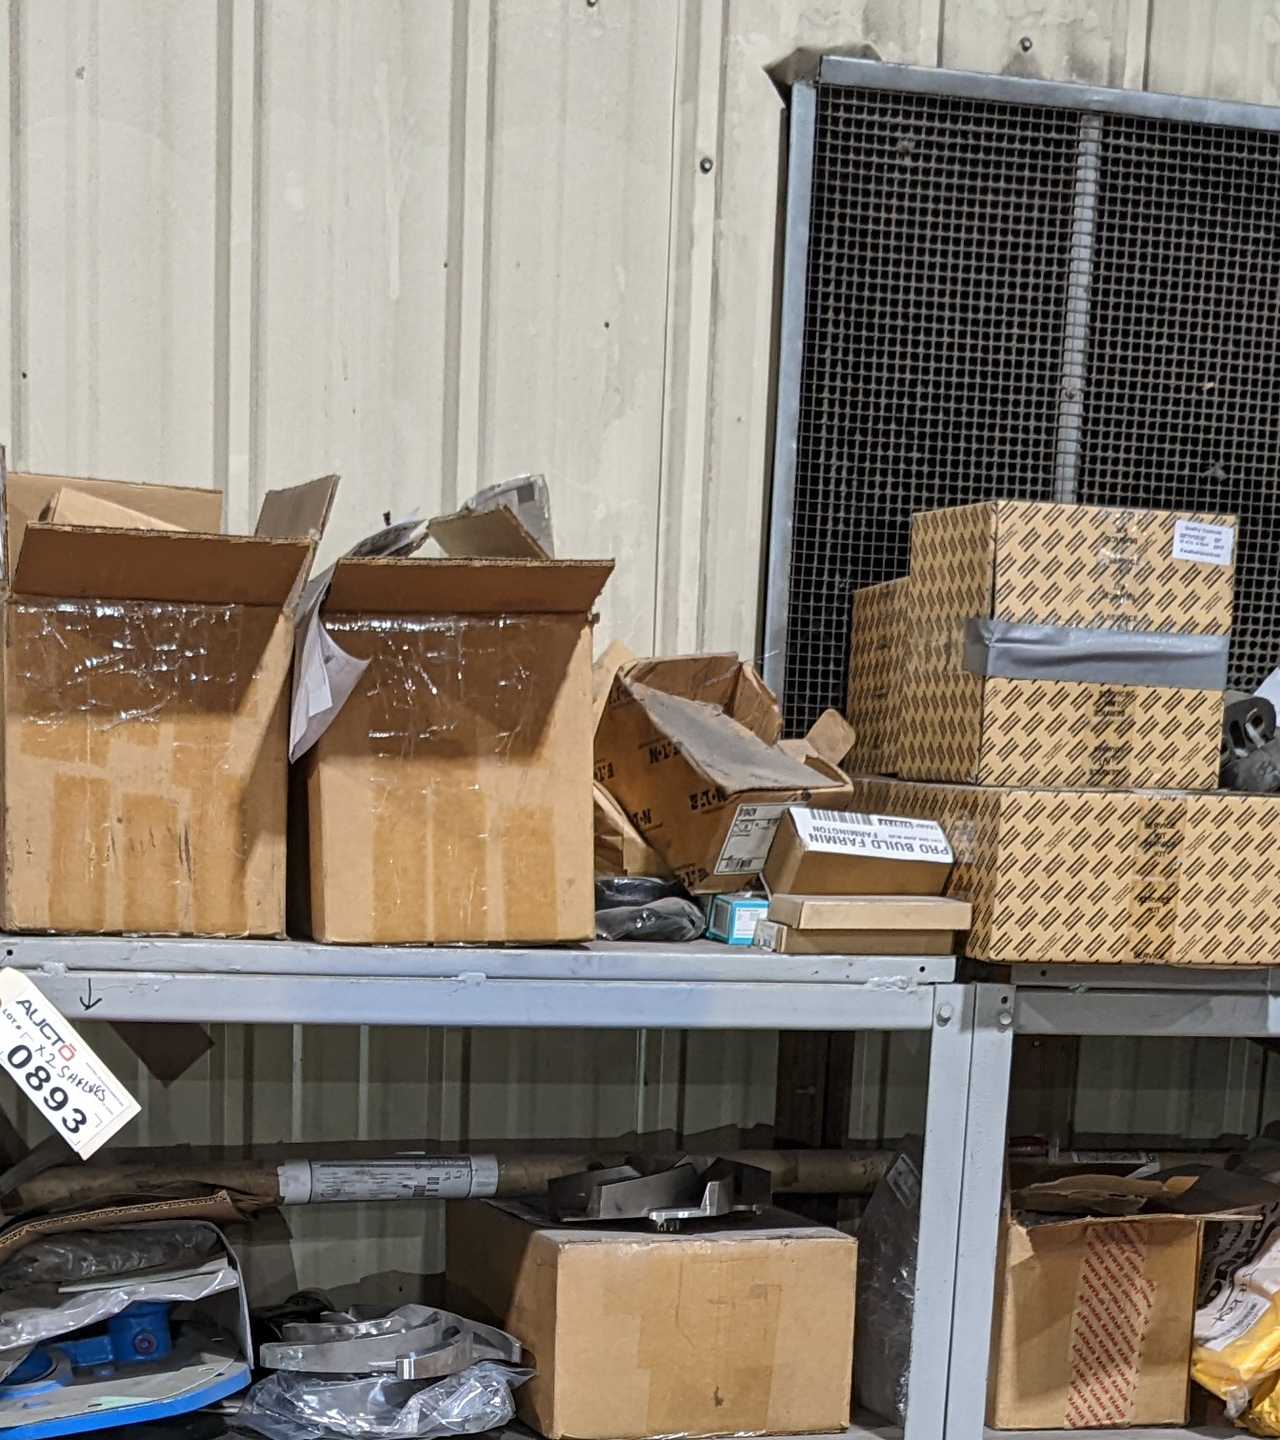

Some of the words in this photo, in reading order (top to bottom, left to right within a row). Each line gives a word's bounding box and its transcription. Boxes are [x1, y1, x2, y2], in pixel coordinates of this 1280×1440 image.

[812, 826, 878, 839] FARMINGTON
[870, 839, 915, 853] BUILD
[918, 842, 950, 856] PRO
[2, 1008, 17, 1025] LOT
[7, 1044, 88, 1135] 0893
